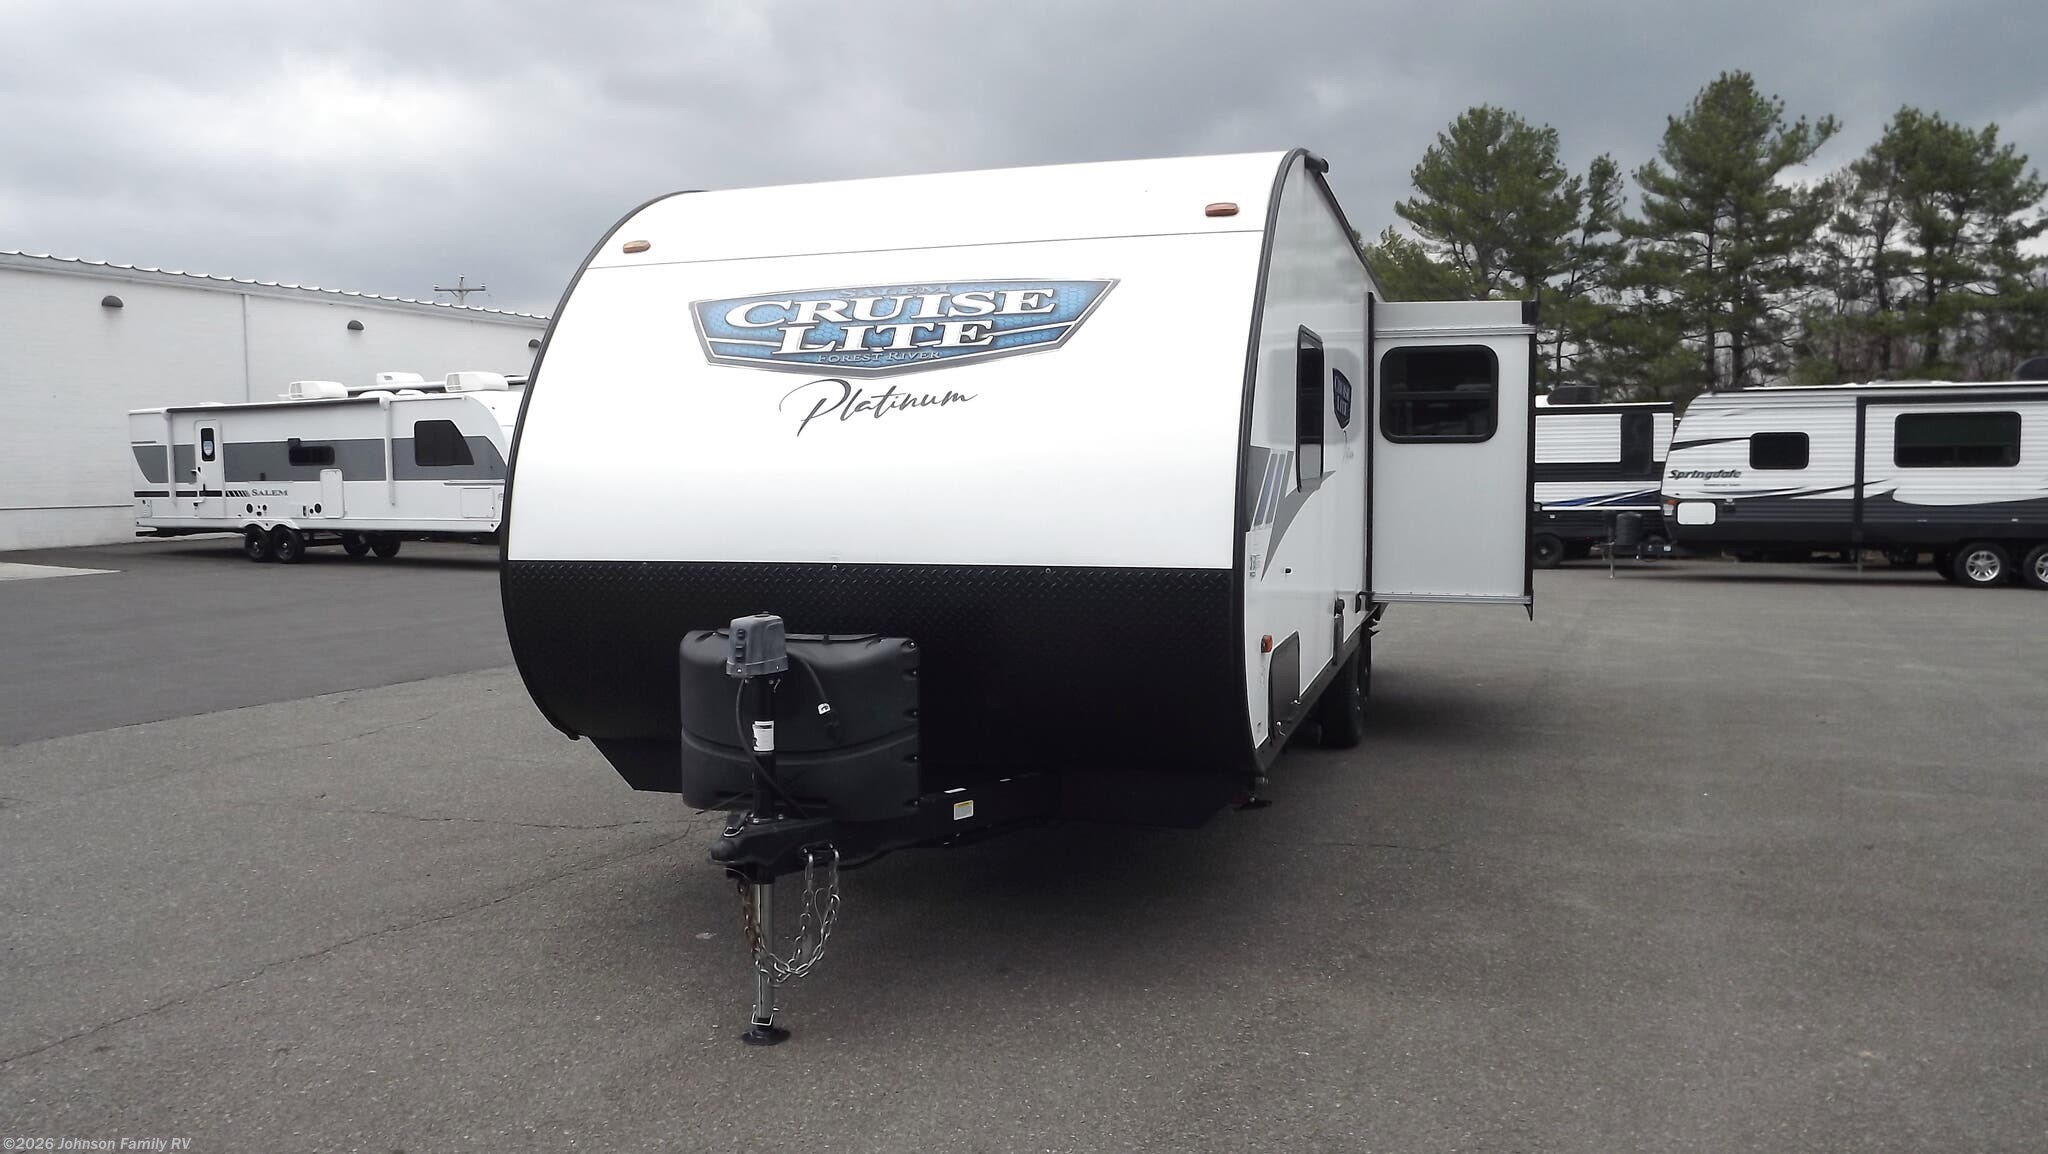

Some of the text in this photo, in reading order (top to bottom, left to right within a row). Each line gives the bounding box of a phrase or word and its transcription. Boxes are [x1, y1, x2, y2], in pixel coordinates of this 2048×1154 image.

[837, 283, 950, 299] SALEM
[723, 287, 1056, 328] CRUISE
[771, 319, 995, 356] LITE
[816, 350, 941, 364] FOREST RIVER
[778, 377, 978, 438] Platinum
[1667, 469, 1742, 481] Springdale
